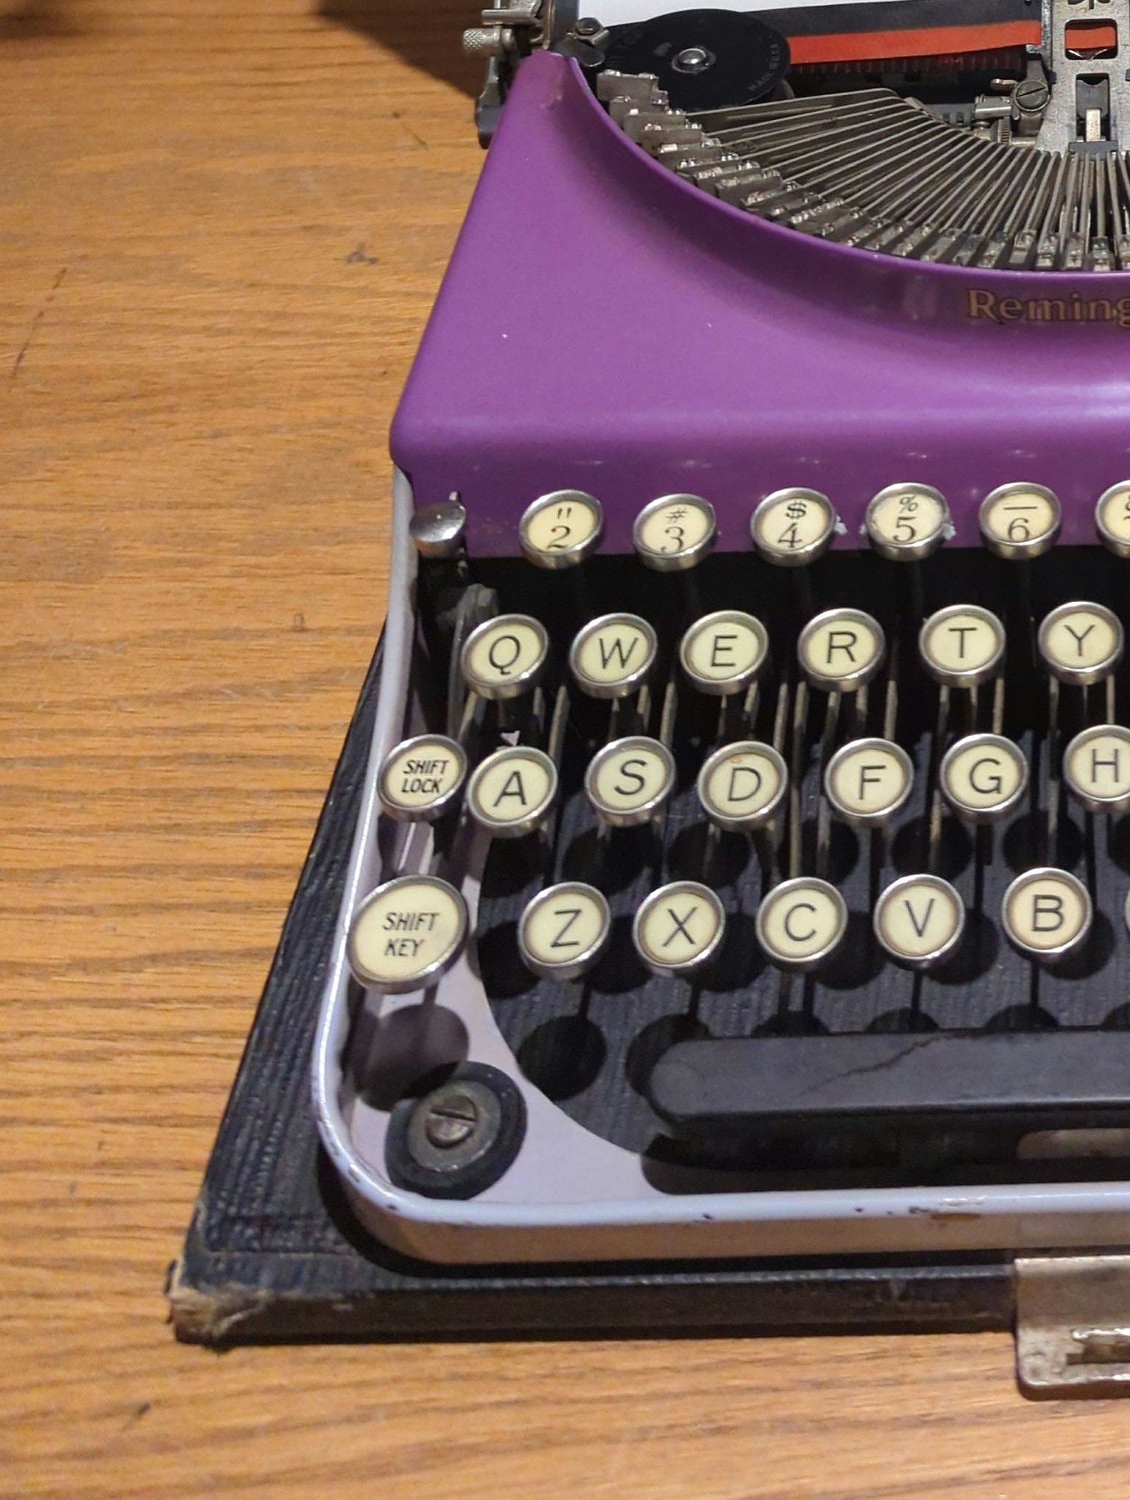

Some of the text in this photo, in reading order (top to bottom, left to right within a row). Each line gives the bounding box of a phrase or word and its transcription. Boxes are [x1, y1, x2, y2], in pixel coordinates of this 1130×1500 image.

[665, 507, 687, 523] #
[786, 501, 807, 519] $
[899, 494, 919, 514] %
[546, 525, 571, 549] 2
[661, 526, 684, 552] 3
[778, 522, 803, 548] 4
[893, 516, 916, 542] 5
[1007, 517, 1030, 541] 6
[488, 635, 520, 675] Q
[599, 637, 638, 670] W
[710, 635, 739, 667] E
[826, 631, 857, 664] R
[948, 627, 978, 658] T
[1064, 624, 1096, 657] Y
[402, 759, 449, 776] SHIFT
[613, 759, 648, 796] S
[858, 764, 887, 801] F
[969, 758, 1002, 794] G
[1090, 748, 1120, 784] H
[401, 777, 441, 794] LOCK
[493, 771, 527, 807] A
[727, 767, 762, 802] D
[381, 912, 441, 932] SHIFT
[550, 908, 582, 949] Z
[663, 907, 698, 947] X
[783, 903, 818, 942] C
[904, 898, 936, 938] V
[1031, 894, 1065, 932] B
[383, 938, 424, 957] KEY
